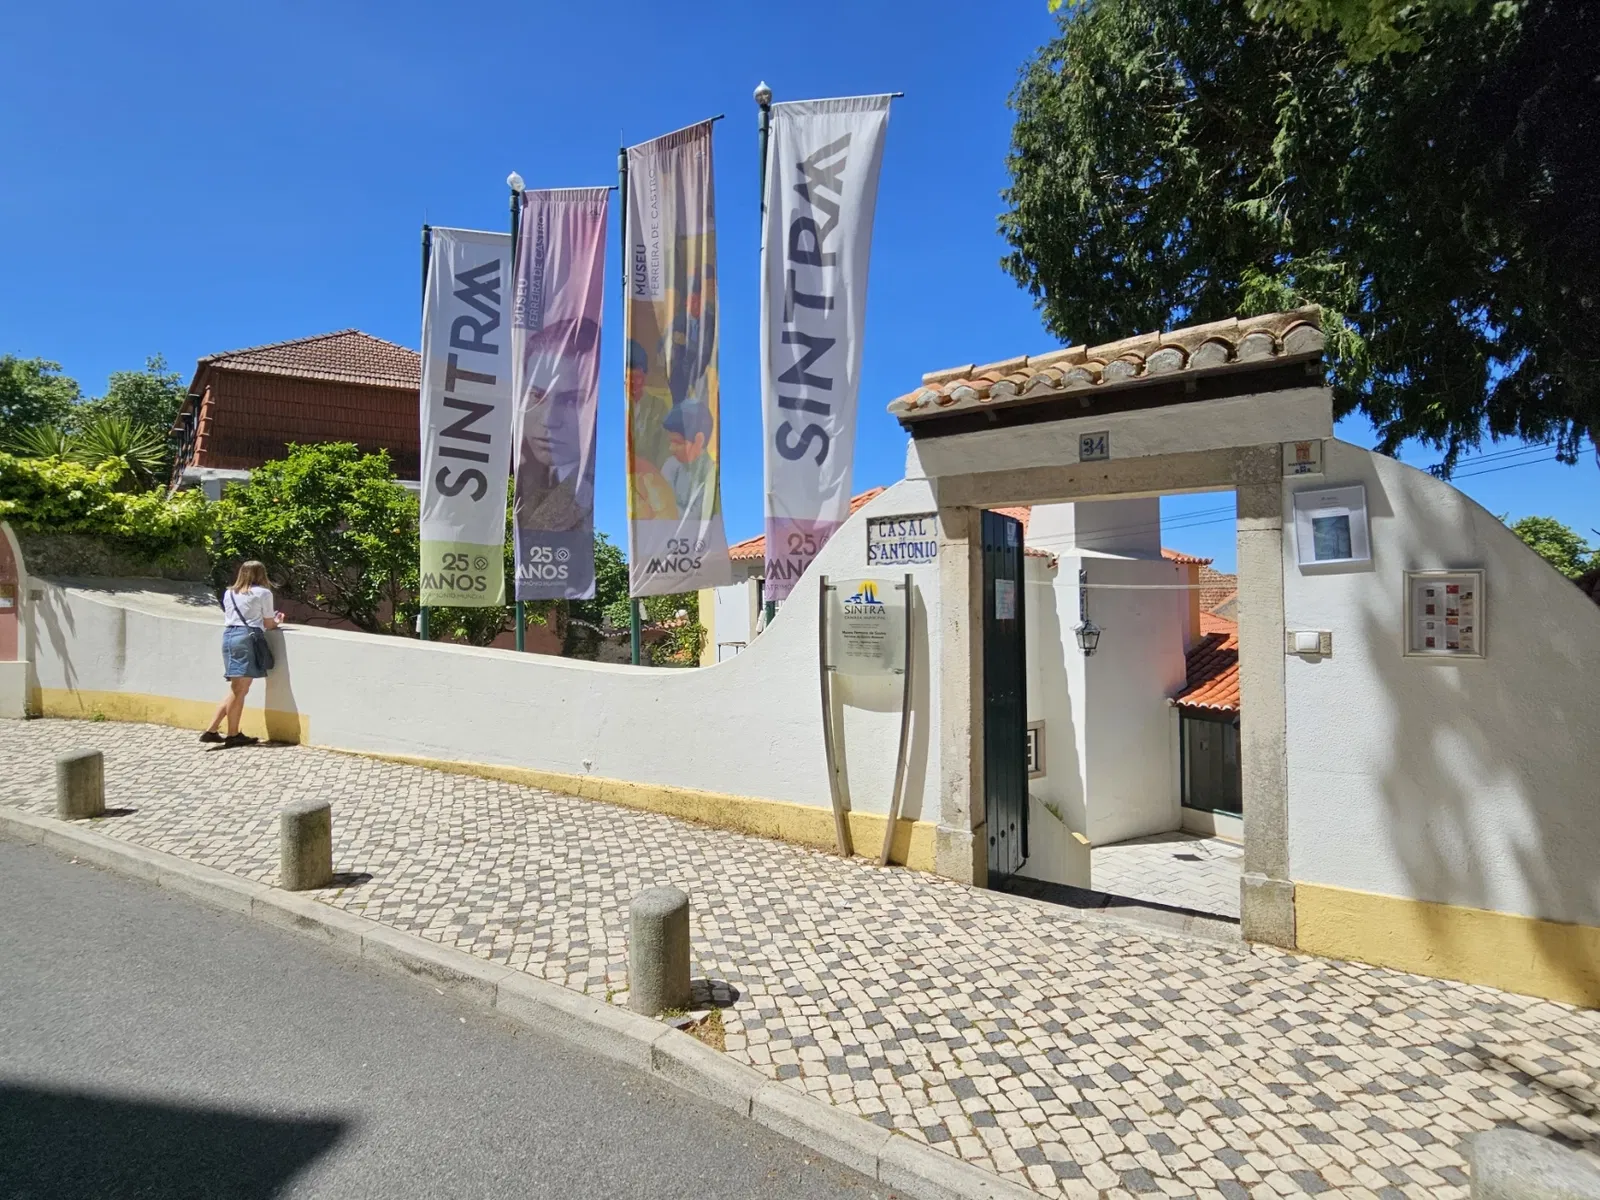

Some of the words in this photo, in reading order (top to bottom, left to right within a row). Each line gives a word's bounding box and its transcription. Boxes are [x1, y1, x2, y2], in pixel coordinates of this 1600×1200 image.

[648, 169, 659, 220] CASTRO
[651, 222, 659, 239] DE
[533, 261, 543, 277] DE
[635, 244, 646, 296] MUSEU
[650, 241, 660, 296] FERREIRA
[514, 278, 529, 326] MUSEU
[529, 279, 542, 328] FERREIRA
[1083, 436, 1105, 456] 34
[879, 519, 927, 537] CASAL
[667, 538, 690, 555] 25
[788, 532, 817, 556] 25
[442, 552, 469, 571] 25
[530, 546, 553, 563] 25
[519, 563, 569, 580] ANOS
[844, 605, 886, 615] SINTRA
